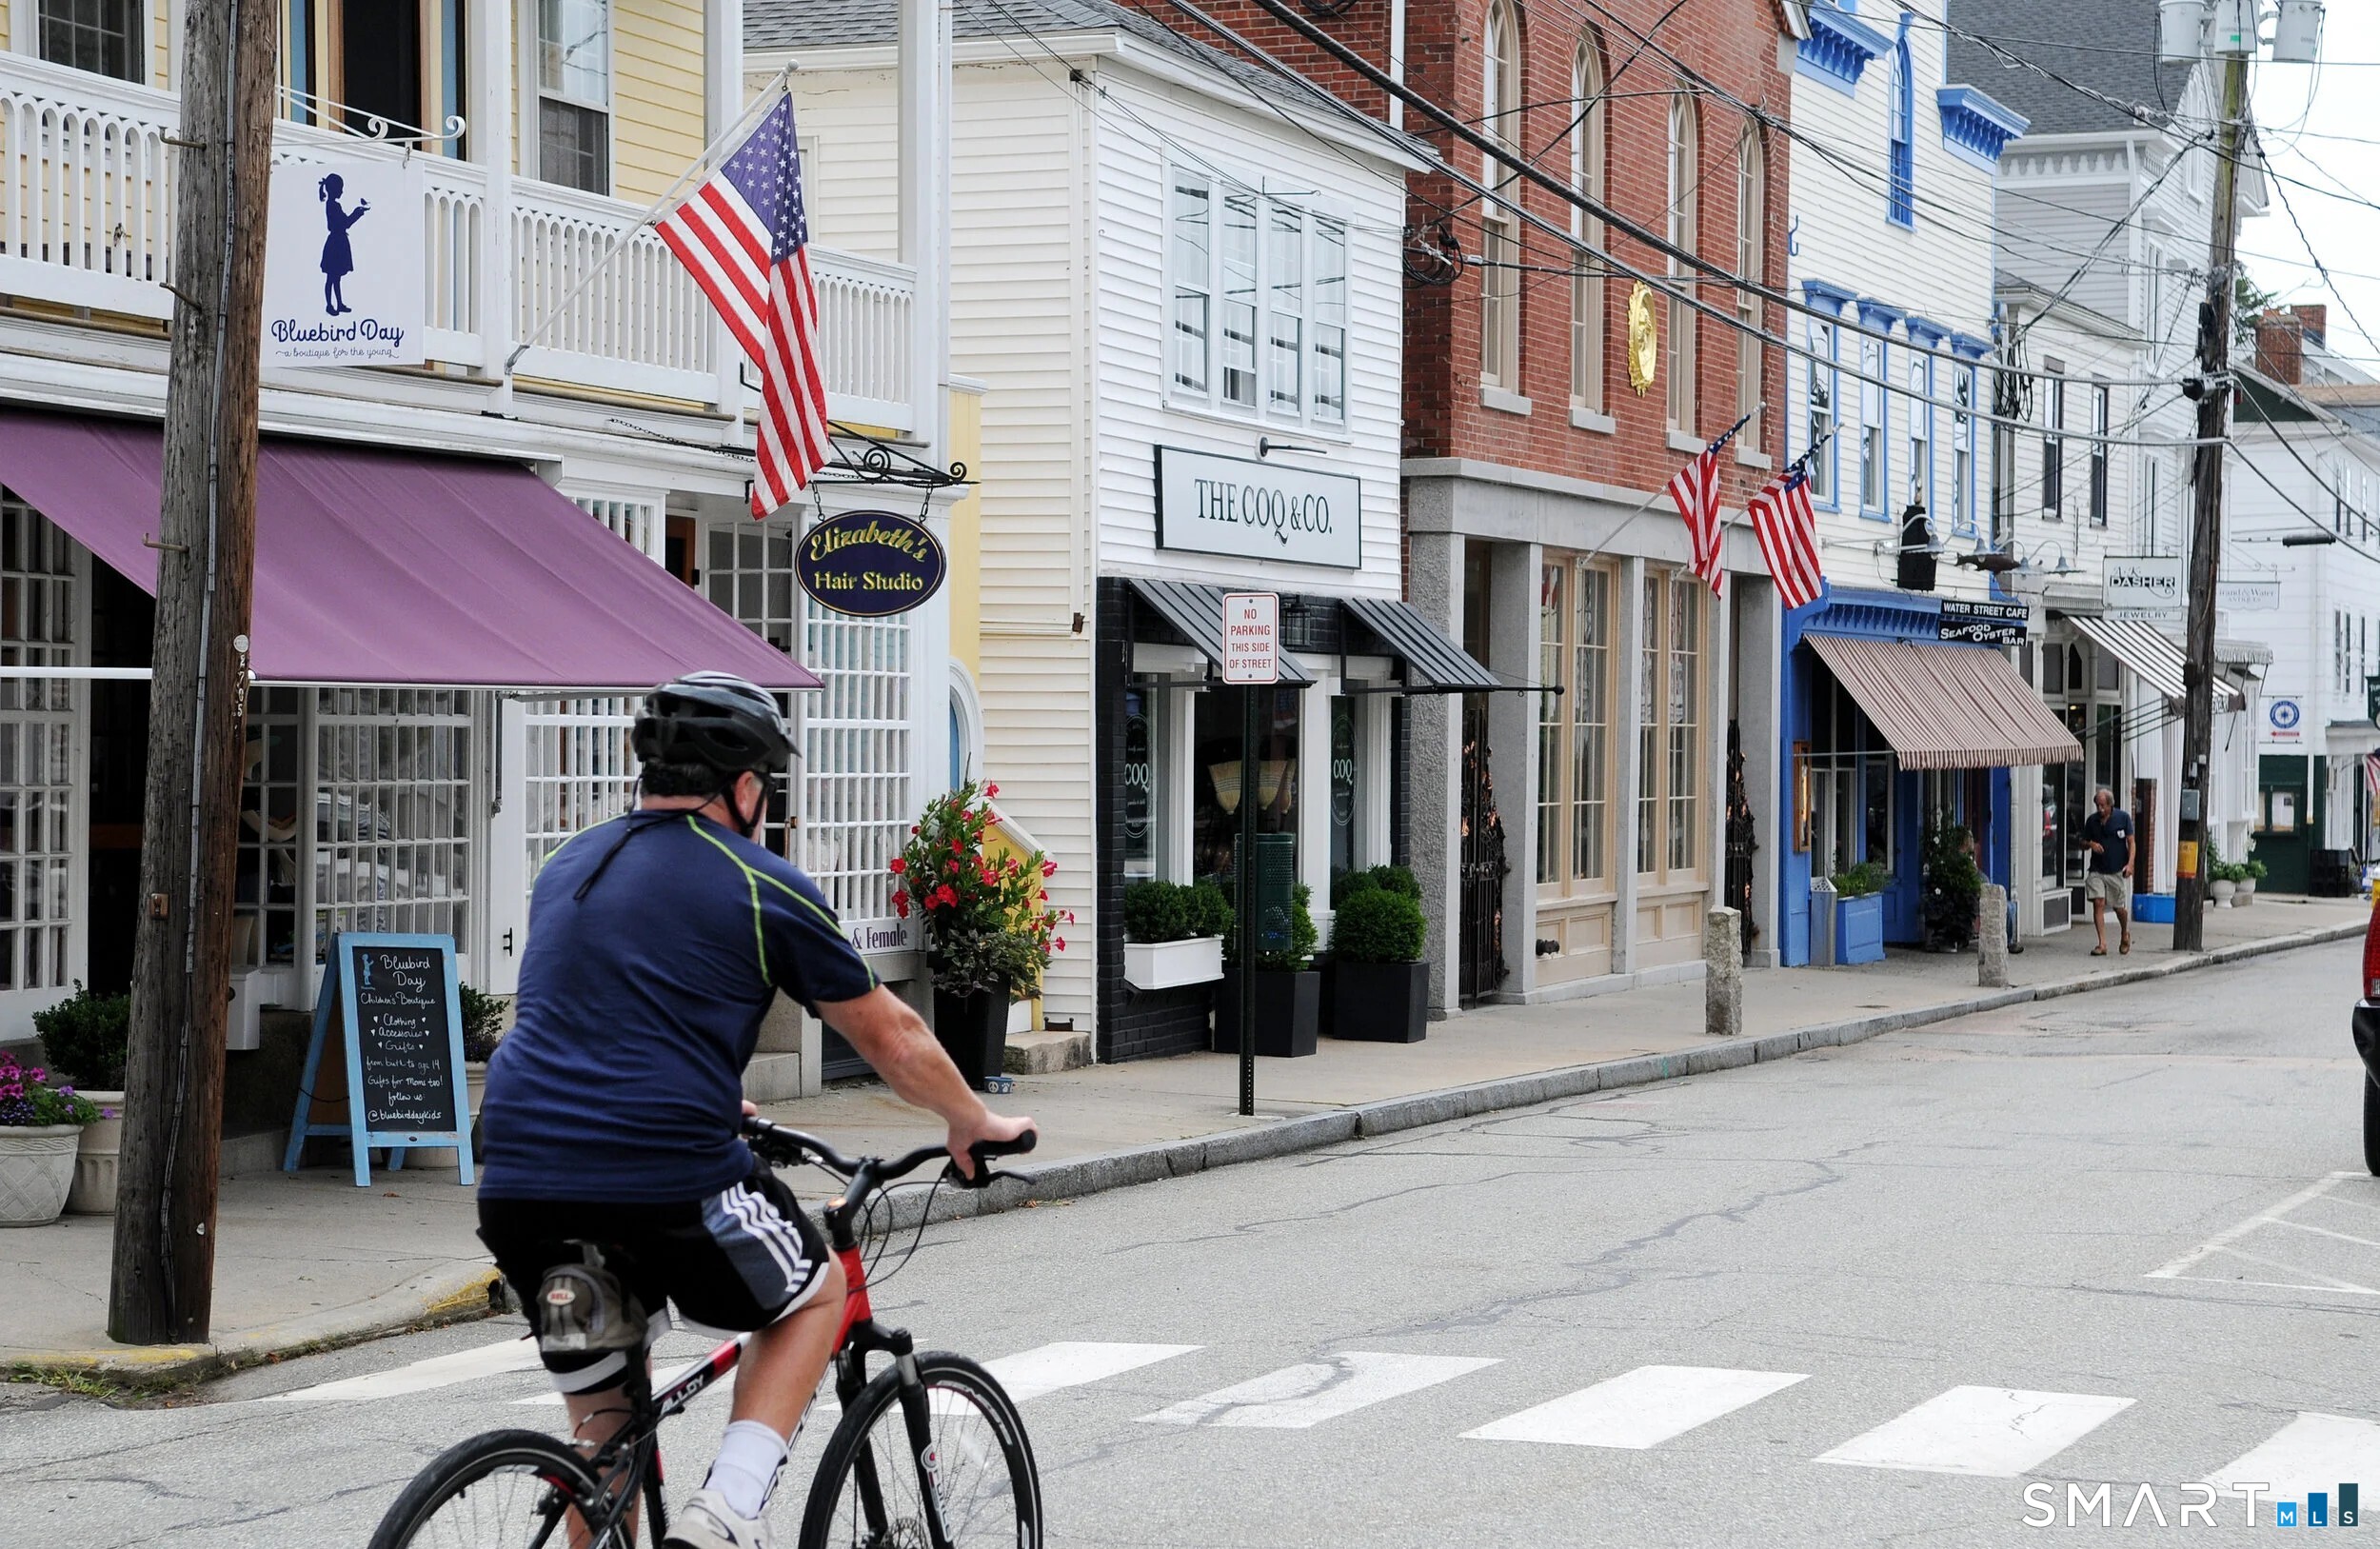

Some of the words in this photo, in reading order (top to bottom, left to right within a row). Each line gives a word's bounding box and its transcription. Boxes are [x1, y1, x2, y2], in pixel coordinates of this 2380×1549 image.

[271, 319, 356, 343] Bluebird
[360, 319, 404, 348] Day
[293, 347, 330, 360] boutique
[333, 347, 348, 361] for
[350, 348, 364, 356] the
[367, 348, 399, 359] young
[1194, 478, 1239, 523] THE
[1241, 485, 1289, 546] COQ
[1290, 496, 1302, 530] &
[1302, 493, 1333, 535] CO.
[810, 520, 927, 563] Elizabeth's
[814, 571, 858, 590] Hair
[863, 571, 924, 591] Studio
[2110, 576, 2175, 587] DASHER
[1243, 608, 1258, 620] NO
[1943, 602, 1971, 614] WATER
[1973, 606, 2005, 616] STREET
[2006, 607, 2028, 619] CAFE
[2117, 610, 2168, 619] JEWELRY
[1230, 625, 1271, 636] PARKING
[1231, 642, 1249, 652] THIS
[1252, 642, 1270, 652] SIDE
[2002, 636, 2025, 646] BAR
[1229, 659, 1240, 668] OF
[1242, 658, 1272, 668] STREET
[1124, 763, 1150, 794] COQ
[1333, 758, 1353, 786] COQ
[852, 927, 863, 949] &
[866, 923, 907, 949] Female
[380, 954, 430, 970] Bluebird
[392, 971, 426, 993] Day
[360, 992, 396, 1004] Children's
[395, 991, 435, 1009] Boutique
[383, 1012, 416, 1029] Clothing
[366, 1056, 383, 1070] from
[407, 1059, 415, 1068] to
[418, 1061, 430, 1075] age
[431, 1059, 441, 1070] 14
[367, 1074, 389, 1088] Gifts
[391, 1075, 403, 1088] for
[427, 1075, 444, 1087] too!
[387, 1091, 411, 1106] follow
[660, 1374, 704, 1416] ALLOY
